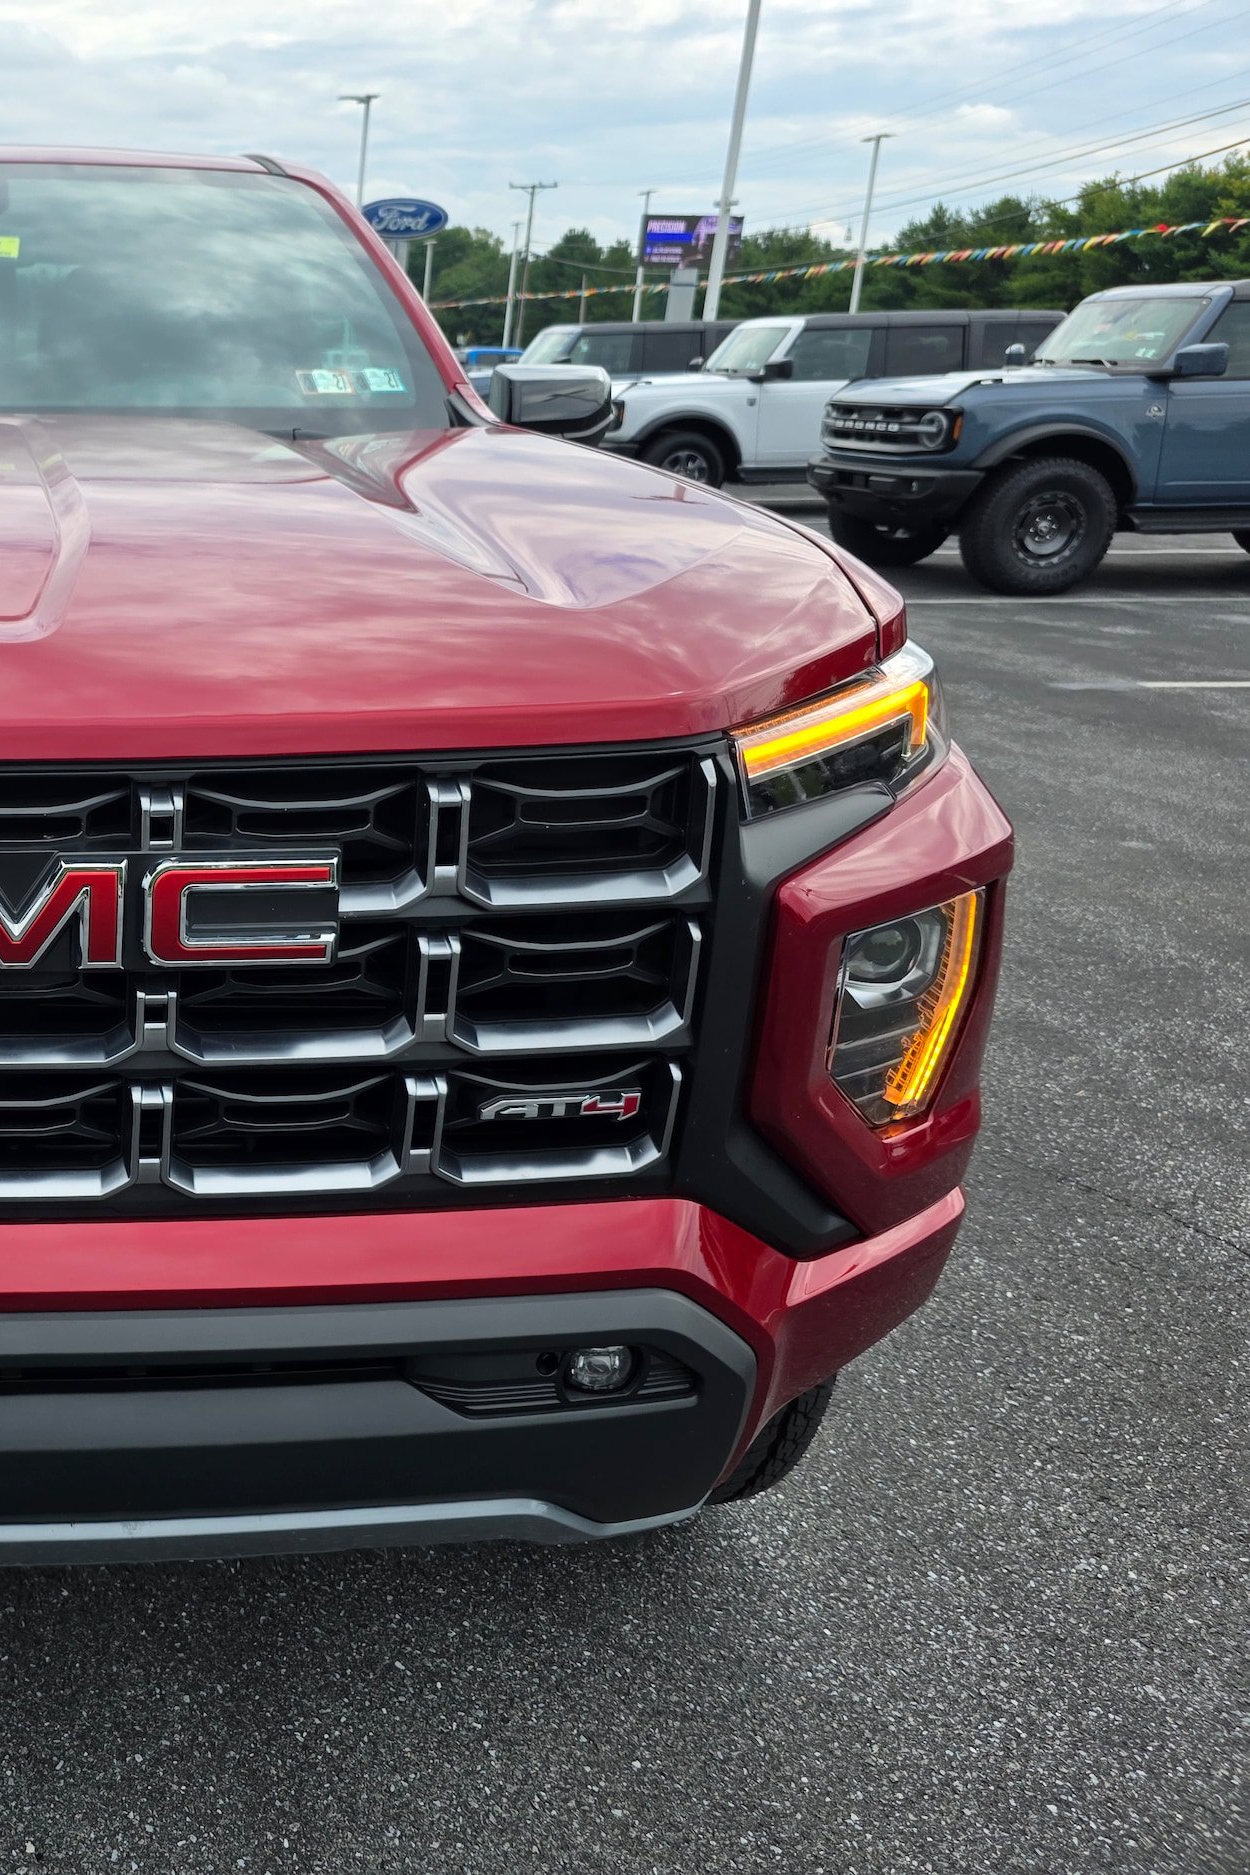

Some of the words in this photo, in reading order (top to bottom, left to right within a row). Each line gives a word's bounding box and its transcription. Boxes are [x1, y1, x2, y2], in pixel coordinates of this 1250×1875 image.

[372, 204, 431, 231] Ford
[835, 420, 900, 432] BRONCO
[480, 1093, 642, 1121] AT4
